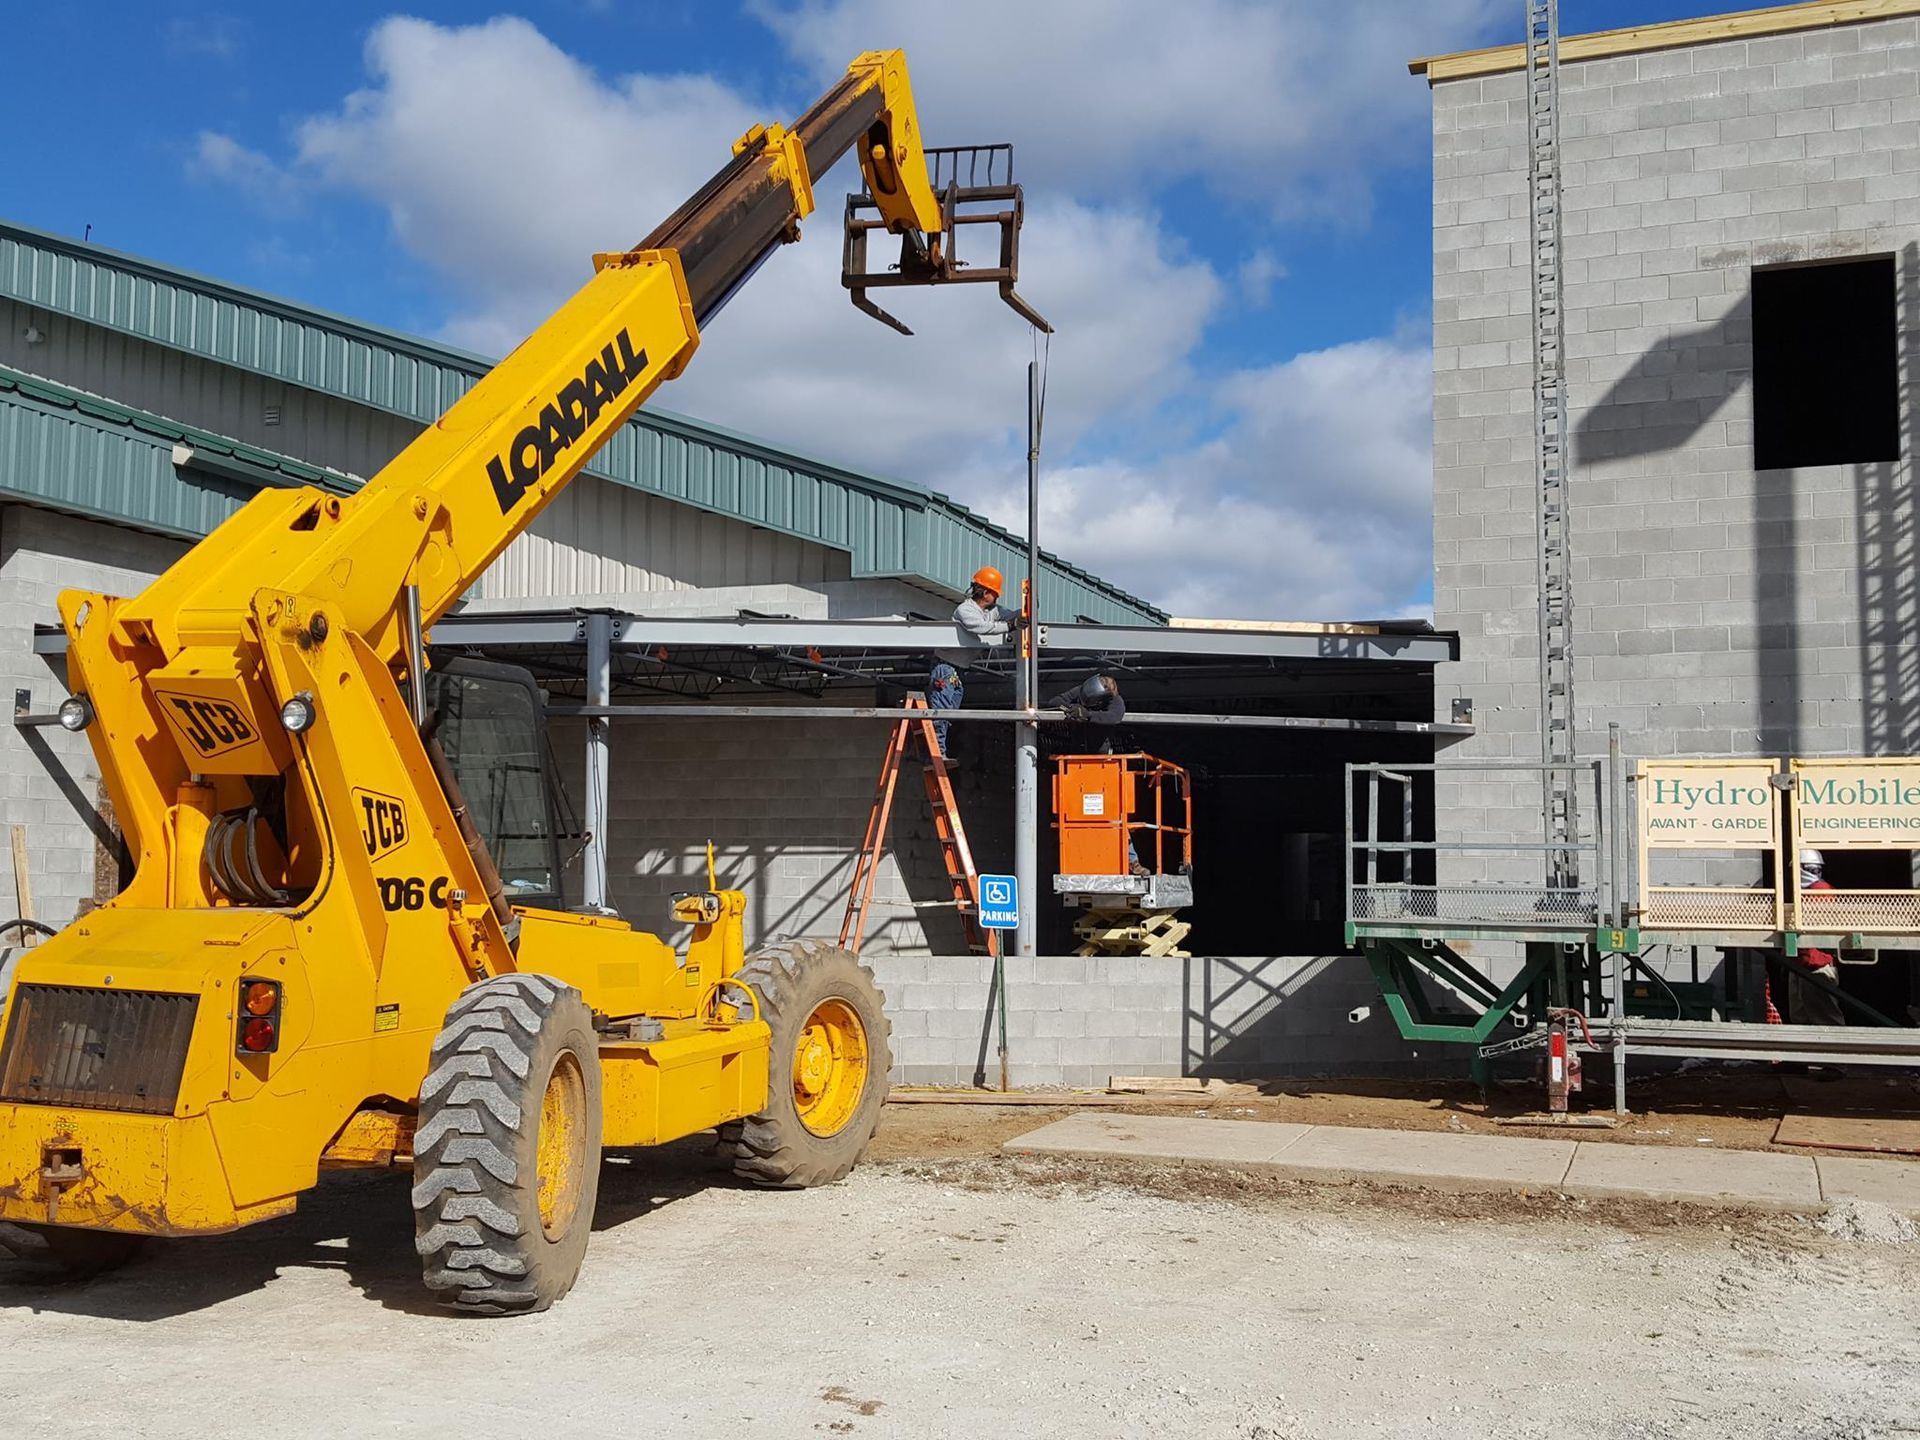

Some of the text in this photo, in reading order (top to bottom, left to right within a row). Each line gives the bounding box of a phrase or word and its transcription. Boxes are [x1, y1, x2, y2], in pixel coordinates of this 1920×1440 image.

[486, 327, 649, 516] LOADALL
[170, 697, 251, 752] JCB
[1653, 778, 1920, 810] Hydro Mobile
[361, 796, 405, 855] JCB
[1650, 818, 1697, 829] AVANT
[1711, 818, 1768, 829] GARDE
[1803, 818, 1920, 829] ENGINEERING
[981, 910, 1018, 921] PARKING
